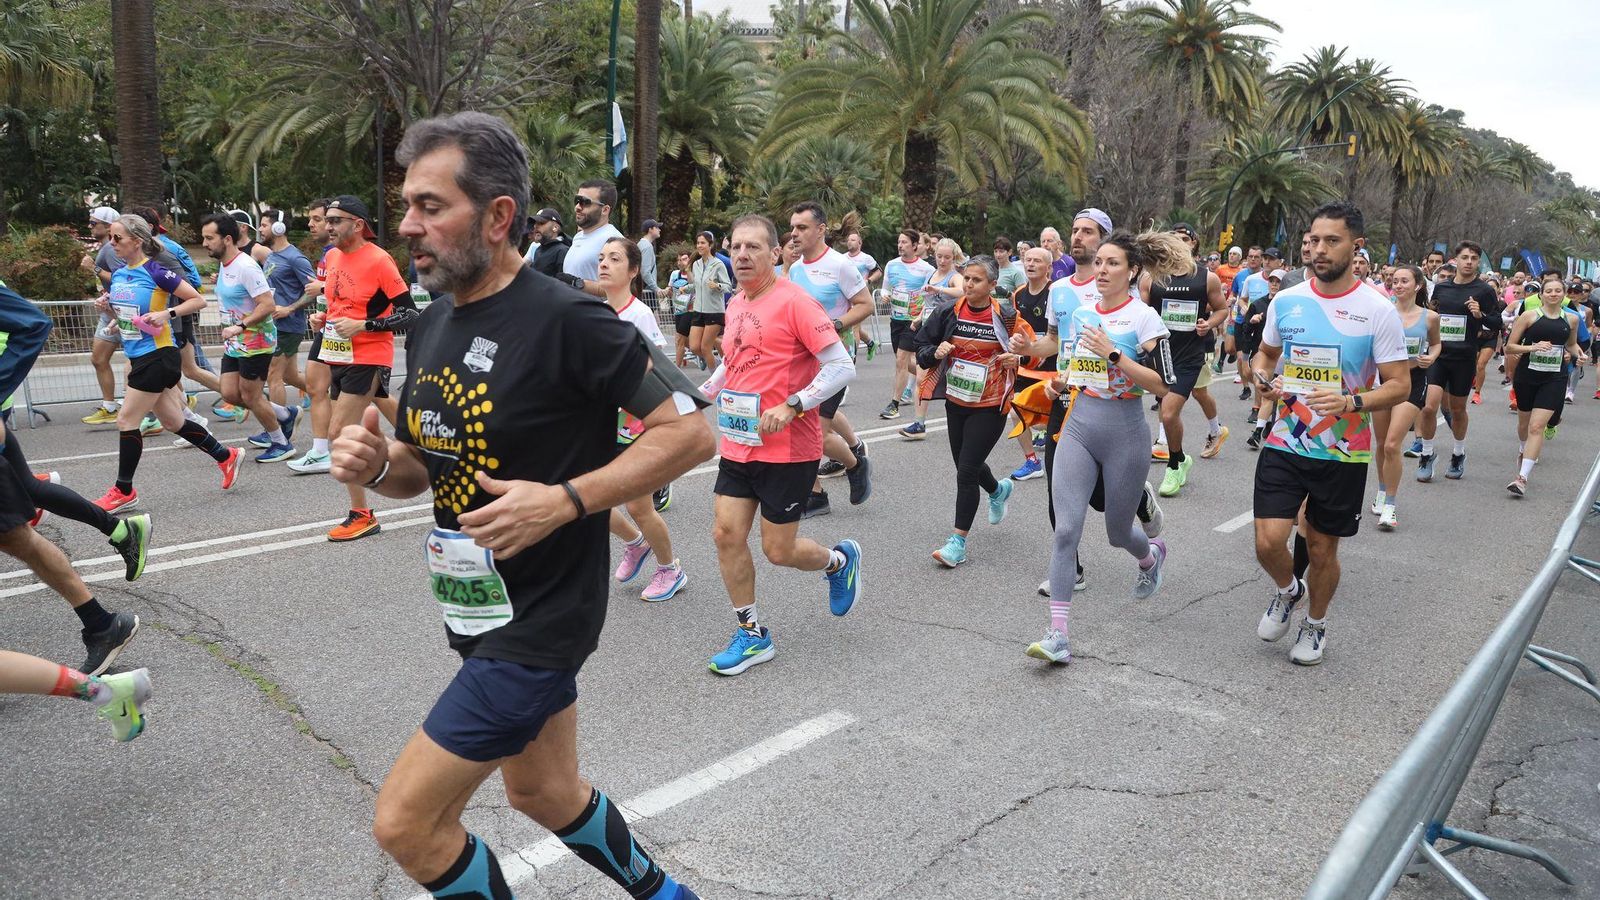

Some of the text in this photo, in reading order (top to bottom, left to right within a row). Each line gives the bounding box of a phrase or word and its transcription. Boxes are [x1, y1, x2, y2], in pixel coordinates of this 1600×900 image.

[1168, 313, 1192, 322] 6385
[1440, 326, 1460, 335] 4397
[325, 341, 346, 351] 3096
[1077, 359, 1101, 373] 3335
[1296, 367, 1330, 382] 2601
[953, 376, 977, 391] 5791
[728, 416, 749, 432] 348
[437, 575, 489, 605] 4235
